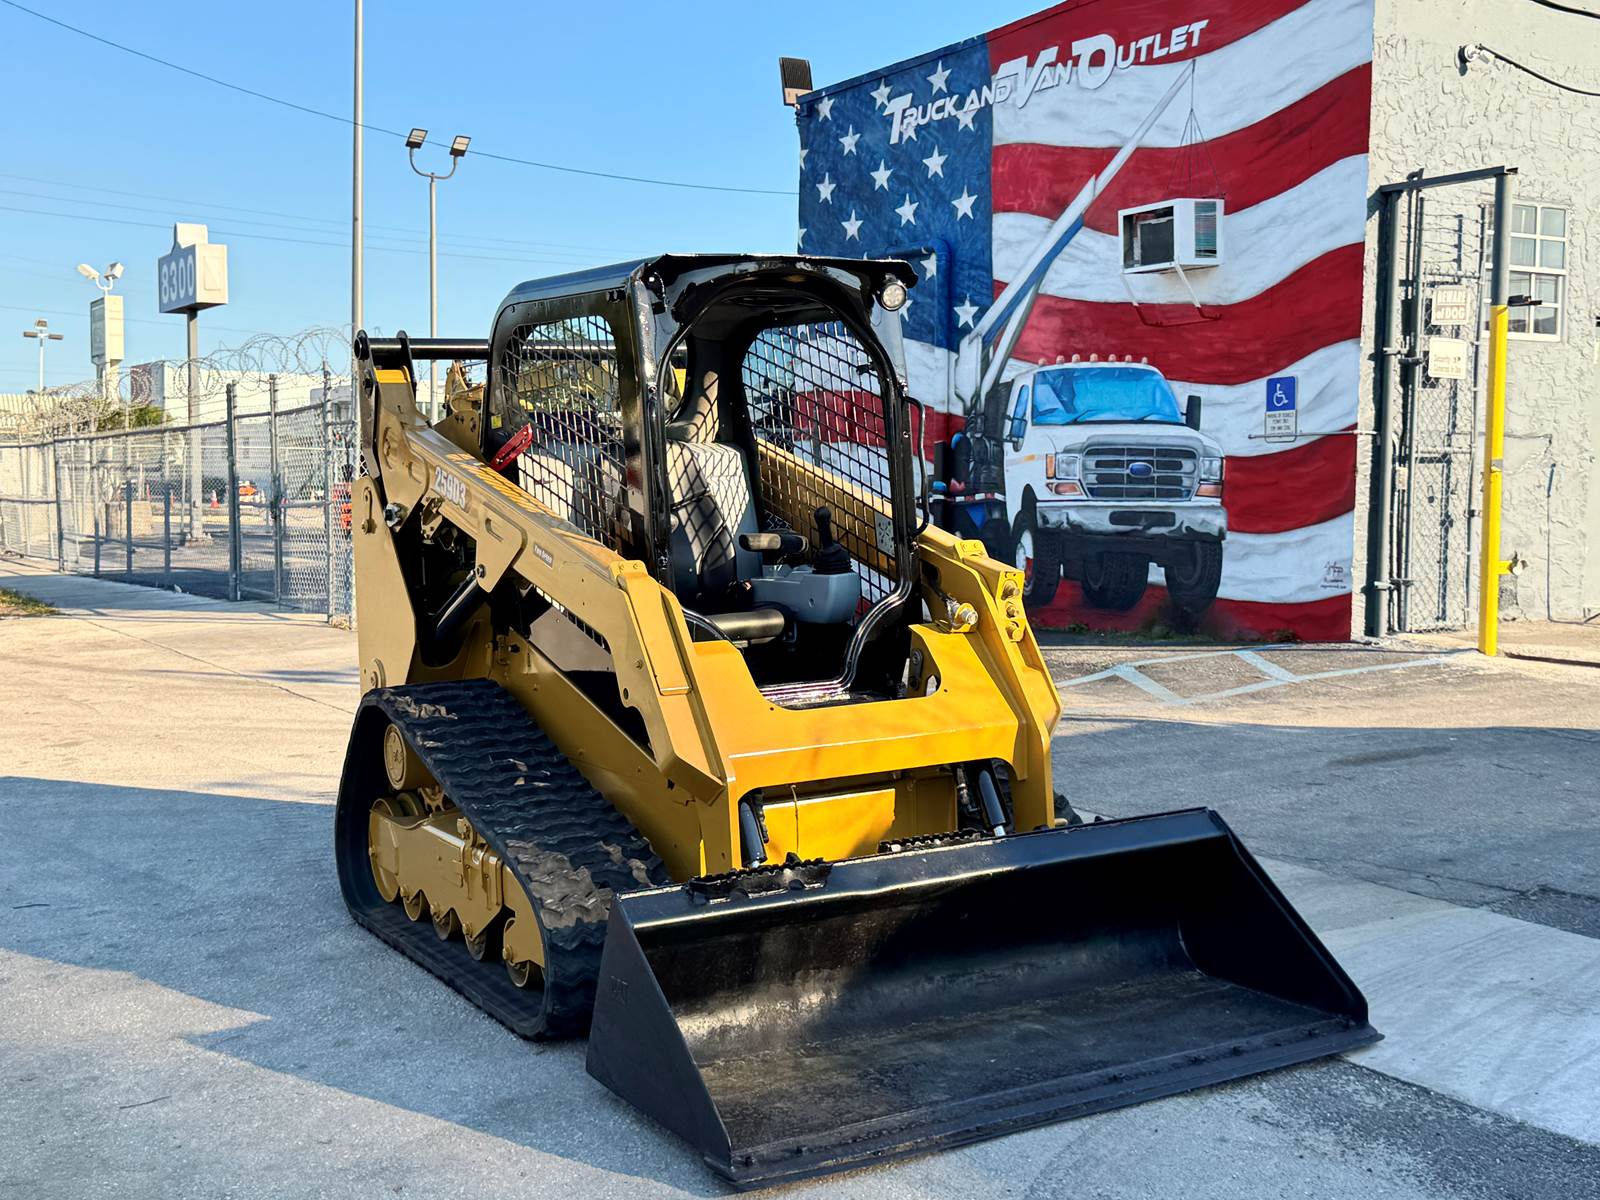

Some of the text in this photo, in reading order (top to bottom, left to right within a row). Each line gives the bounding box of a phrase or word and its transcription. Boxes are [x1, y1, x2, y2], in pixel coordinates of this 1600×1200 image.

[882, 18, 1210, 145] TRUCK AND VAN OUTLET
[161, 253, 195, 304] 8300
[1445, 306, 1465, 319] DOG
[435, 465, 466, 510] 259D3
